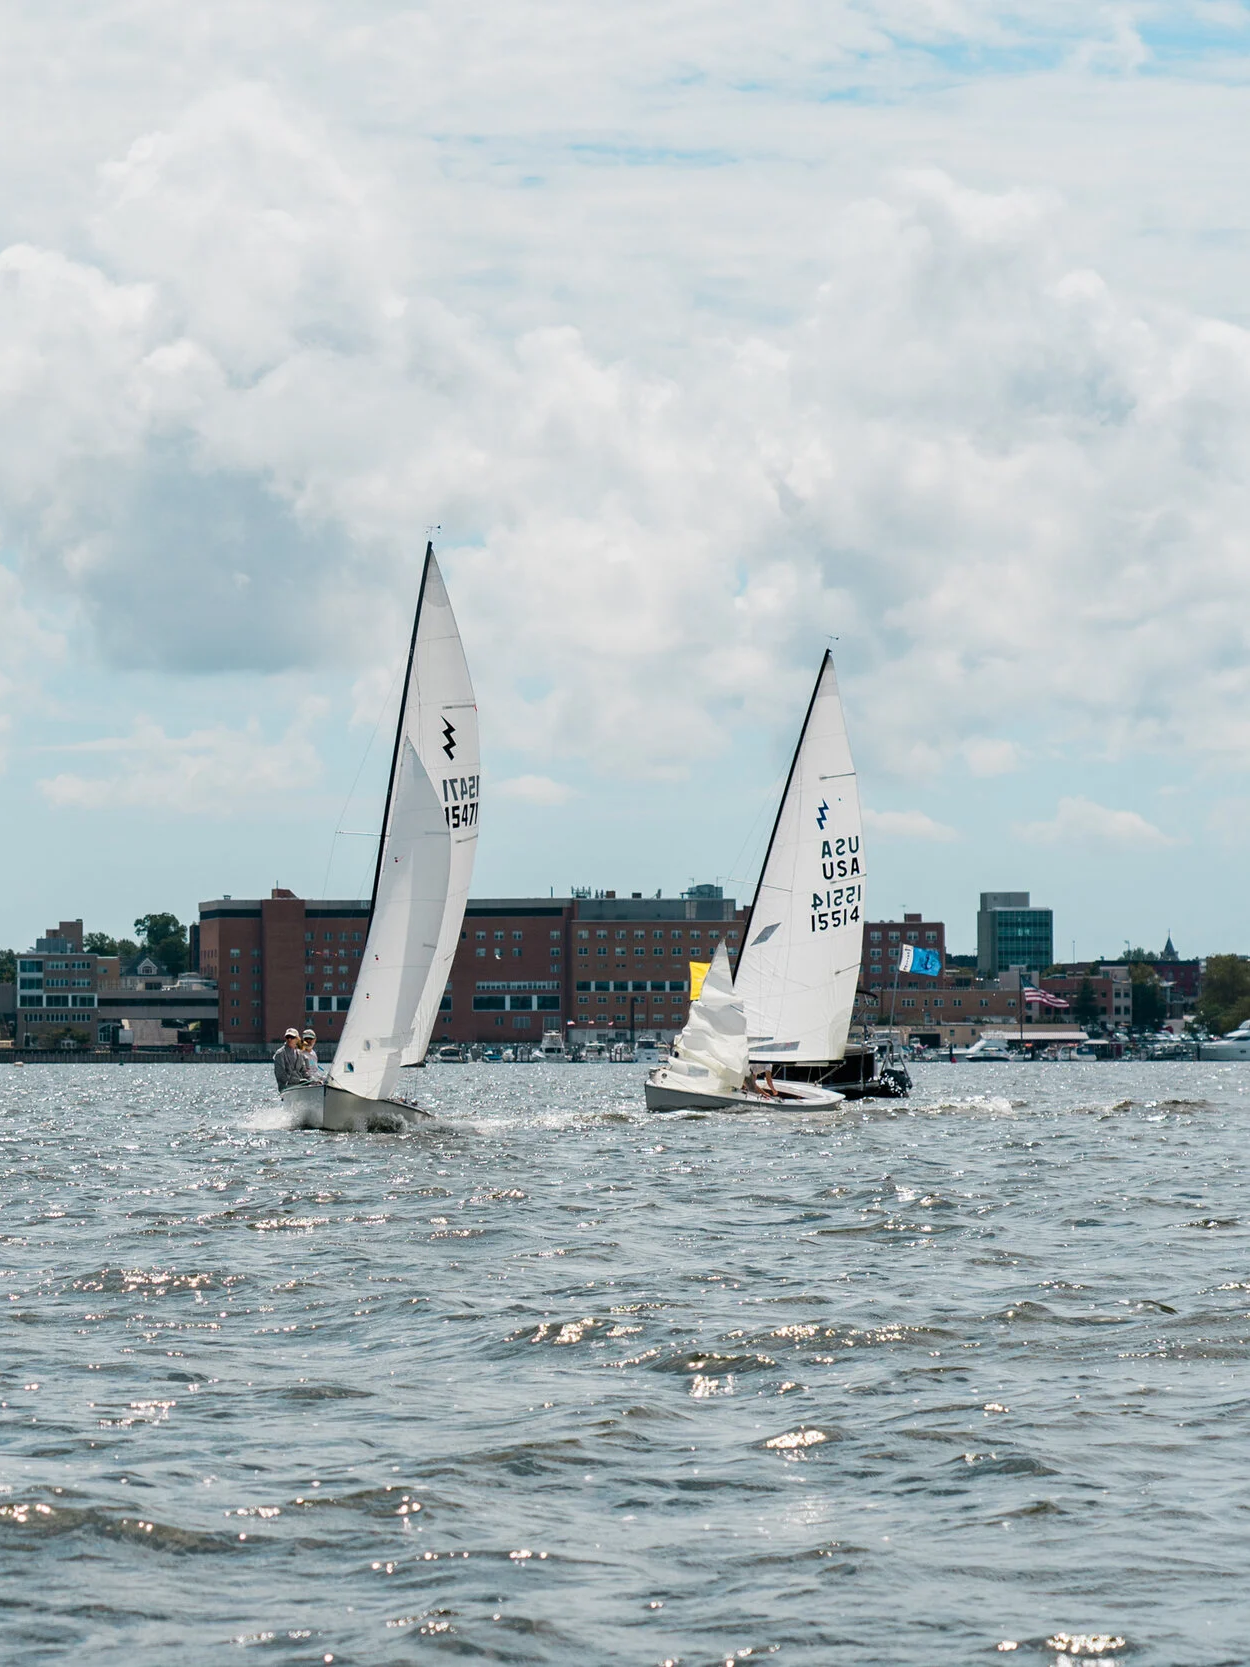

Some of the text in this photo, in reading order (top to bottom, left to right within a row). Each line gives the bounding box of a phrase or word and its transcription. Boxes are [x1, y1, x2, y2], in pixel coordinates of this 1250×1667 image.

[444, 802, 479, 829] 15471
[822, 857, 860, 880] USA
[811, 905, 860, 932] 15514
